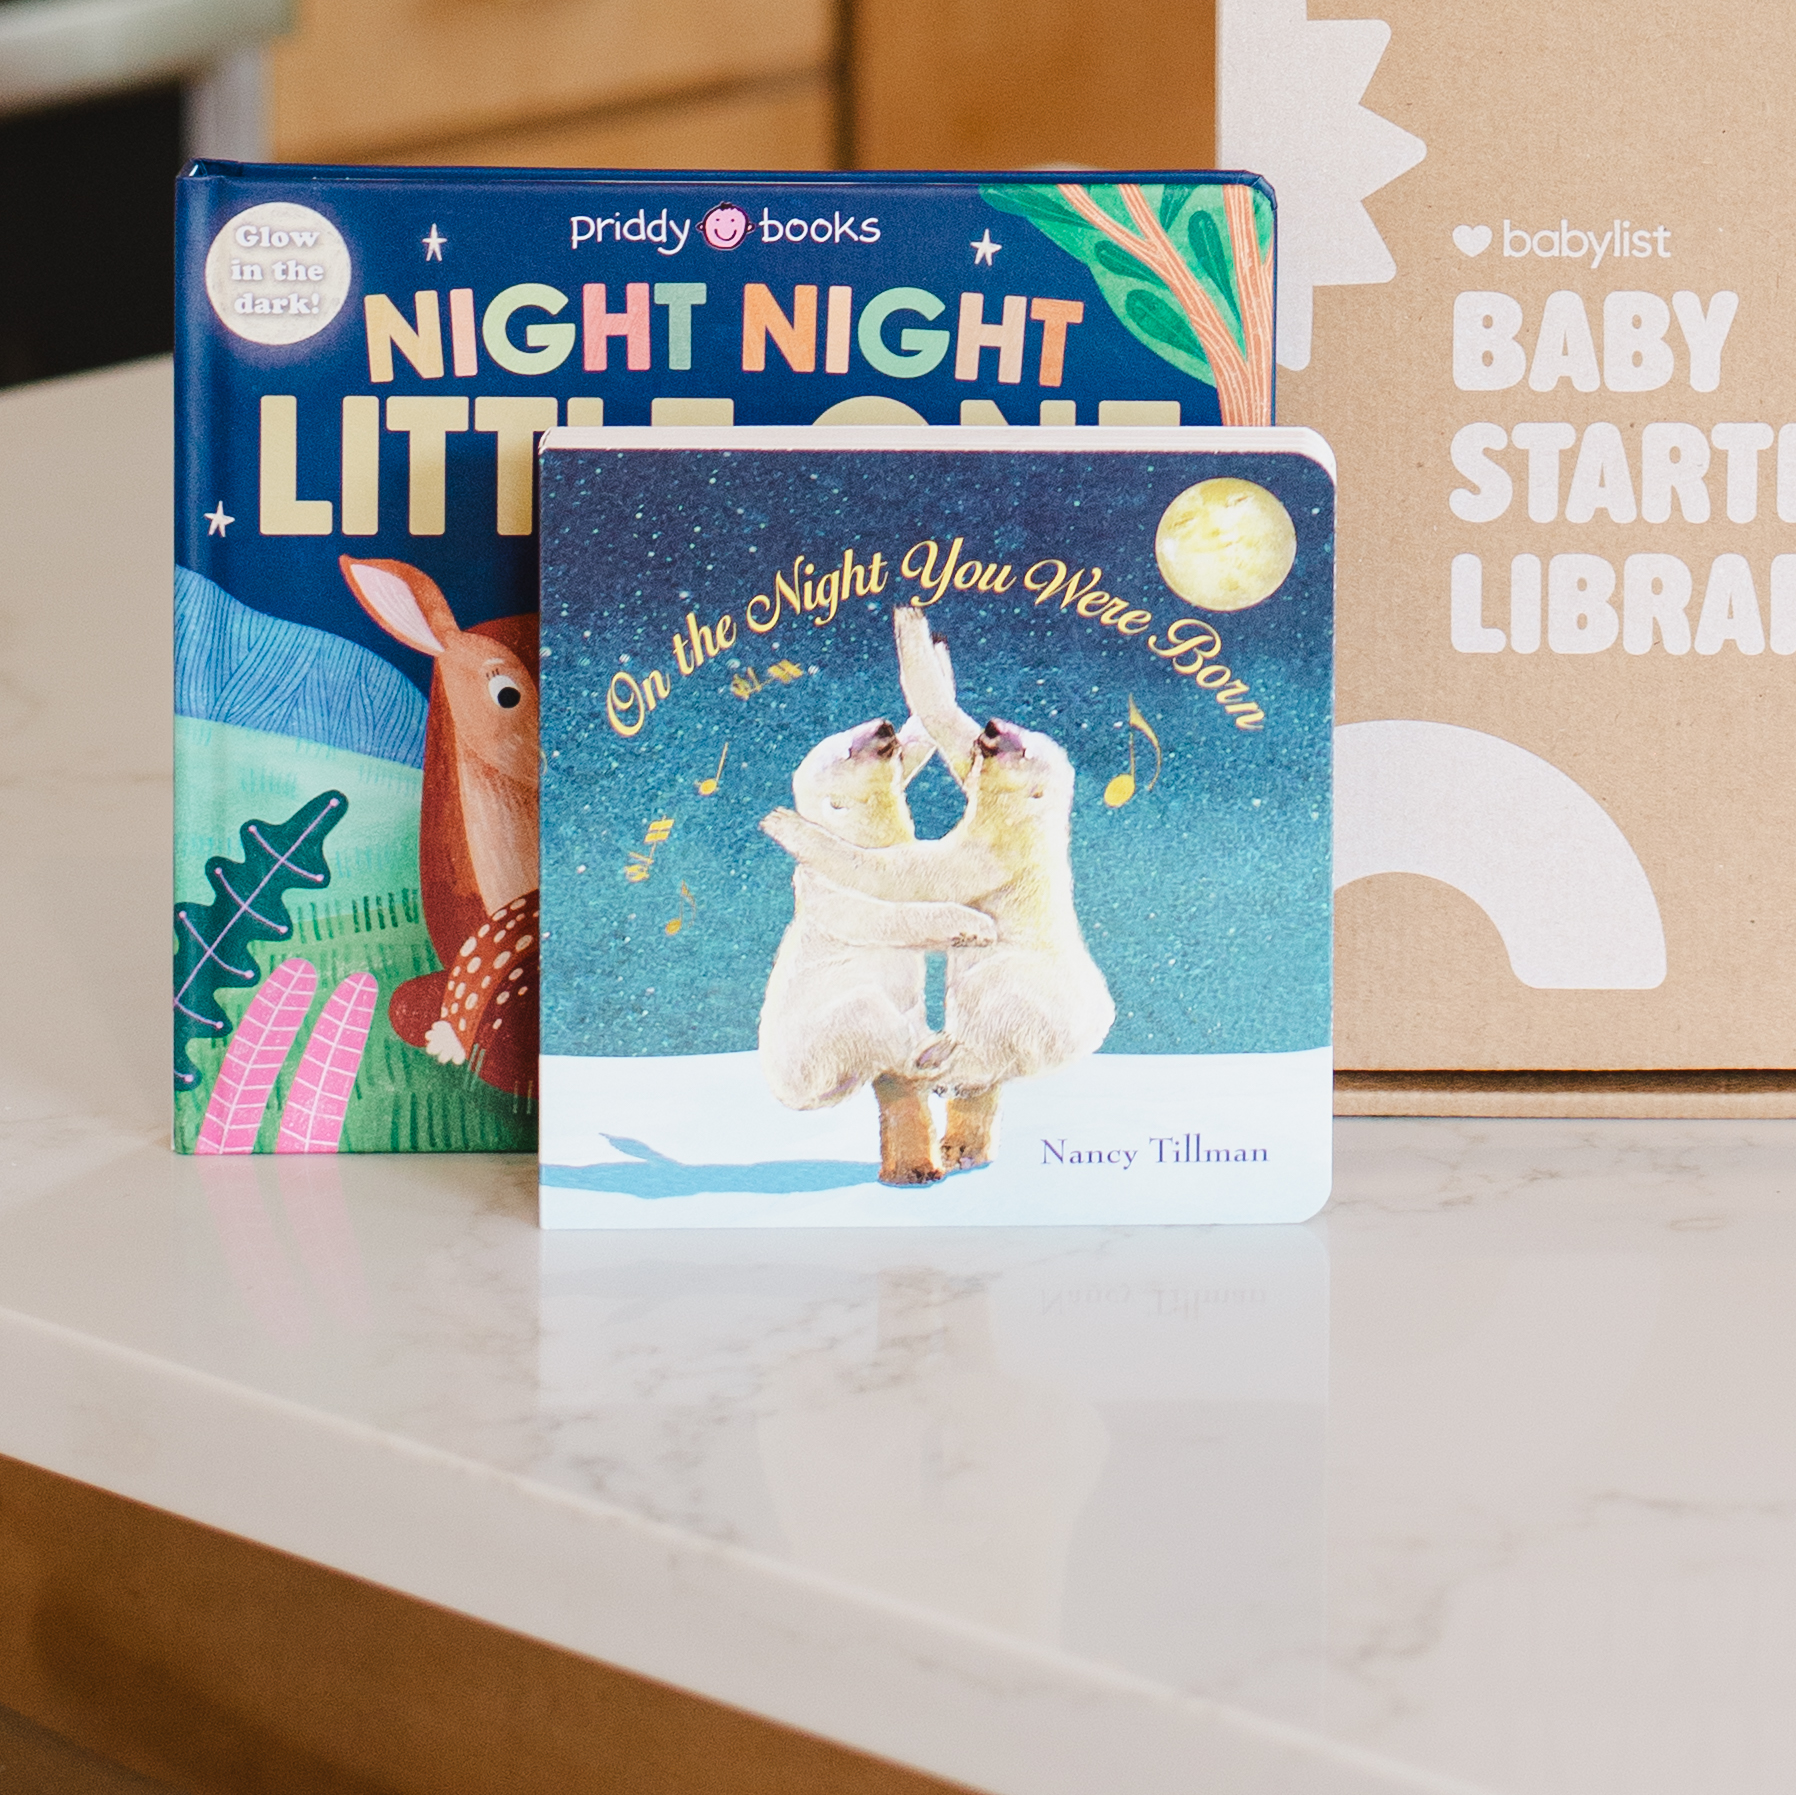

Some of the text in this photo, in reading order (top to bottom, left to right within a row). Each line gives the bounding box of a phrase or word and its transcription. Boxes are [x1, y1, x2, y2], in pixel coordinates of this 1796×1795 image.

[235, 225, 320, 248] Glow
[570, 206, 882, 255] priddy books
[1502, 219, 1672, 269] babylist
[231, 259, 324, 281] in the
[234, 292, 320, 314] dark!
[363, 282, 1085, 387] NIGHT NIGHT
[1452, 290, 1740, 393] BABY
[260, 395, 734, 537] LITT
[606, 537, 1265, 737] On the Night You Were Born
[1040, 1132, 1270, 1170] Nancy Tillman
